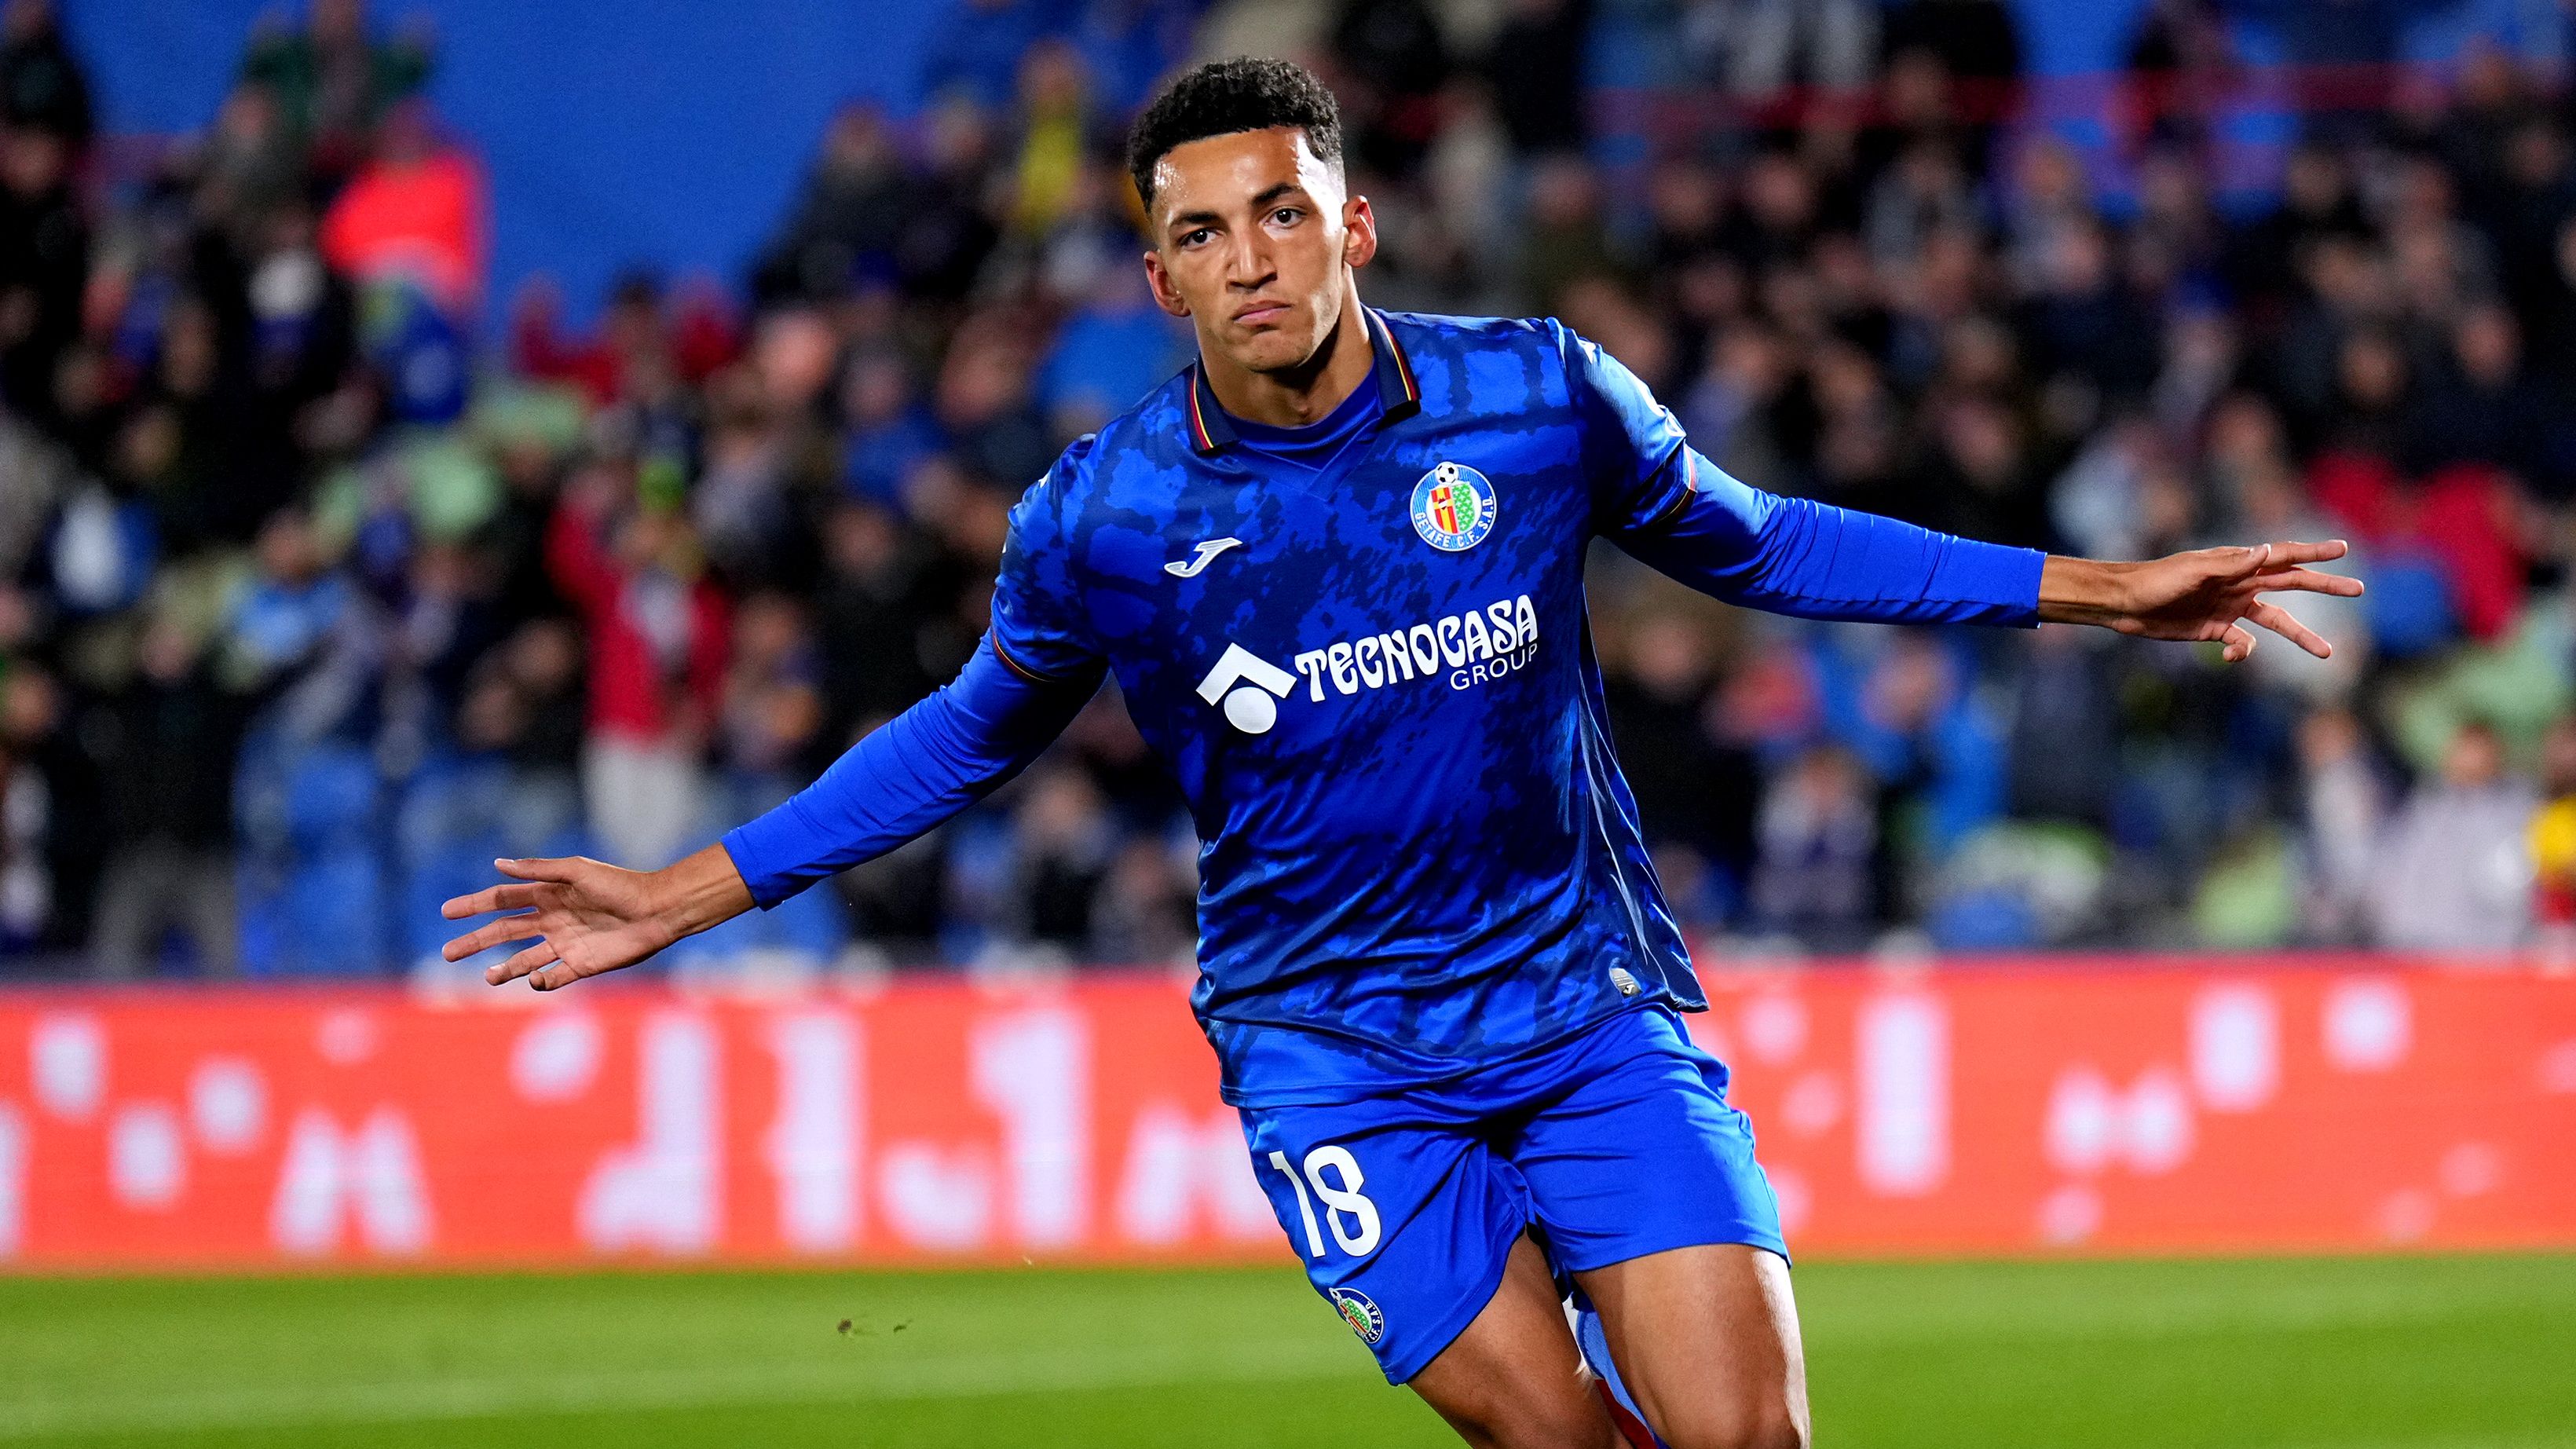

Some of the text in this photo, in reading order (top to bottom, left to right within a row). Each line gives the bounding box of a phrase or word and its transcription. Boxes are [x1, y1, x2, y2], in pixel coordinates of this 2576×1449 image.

[1414, 496, 1494, 547] GETAFE C.F. S.A.D.
[1295, 595, 1539, 702] TECNOCASA
[1450, 642, 1539, 691] GROUP
[1268, 1145, 1381, 1257] 18
